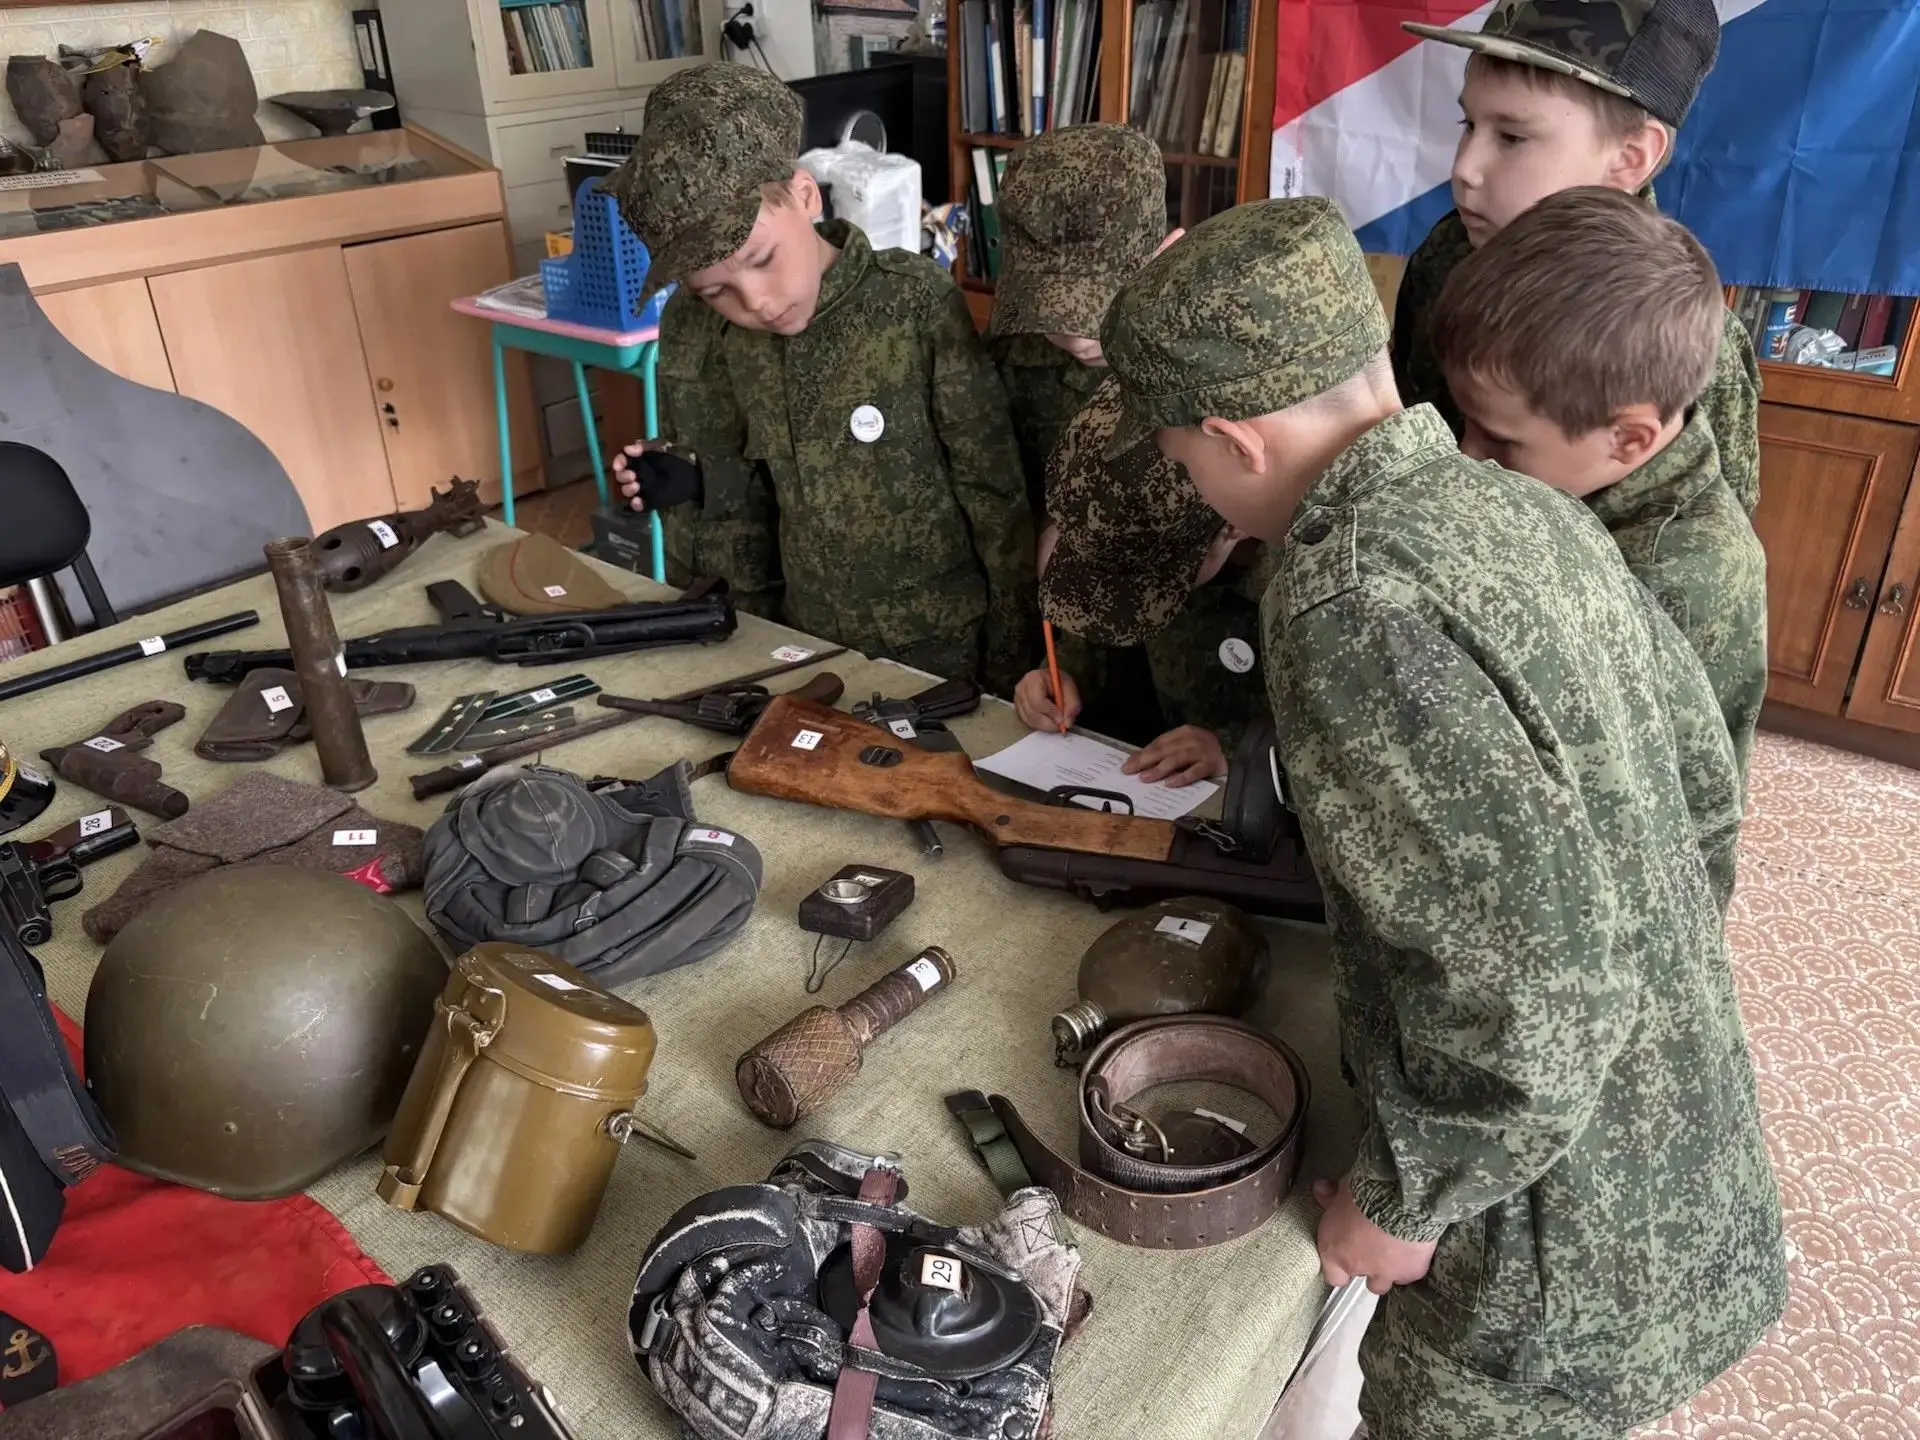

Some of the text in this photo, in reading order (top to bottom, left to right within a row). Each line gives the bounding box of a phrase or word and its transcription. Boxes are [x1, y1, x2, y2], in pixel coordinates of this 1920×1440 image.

[94, 738, 114, 747] 22
[800, 732, 815, 743] 13
[85, 817, 100, 833] 28
[707, 831, 720, 839] 8
[932, 1259, 952, 1284] 29
